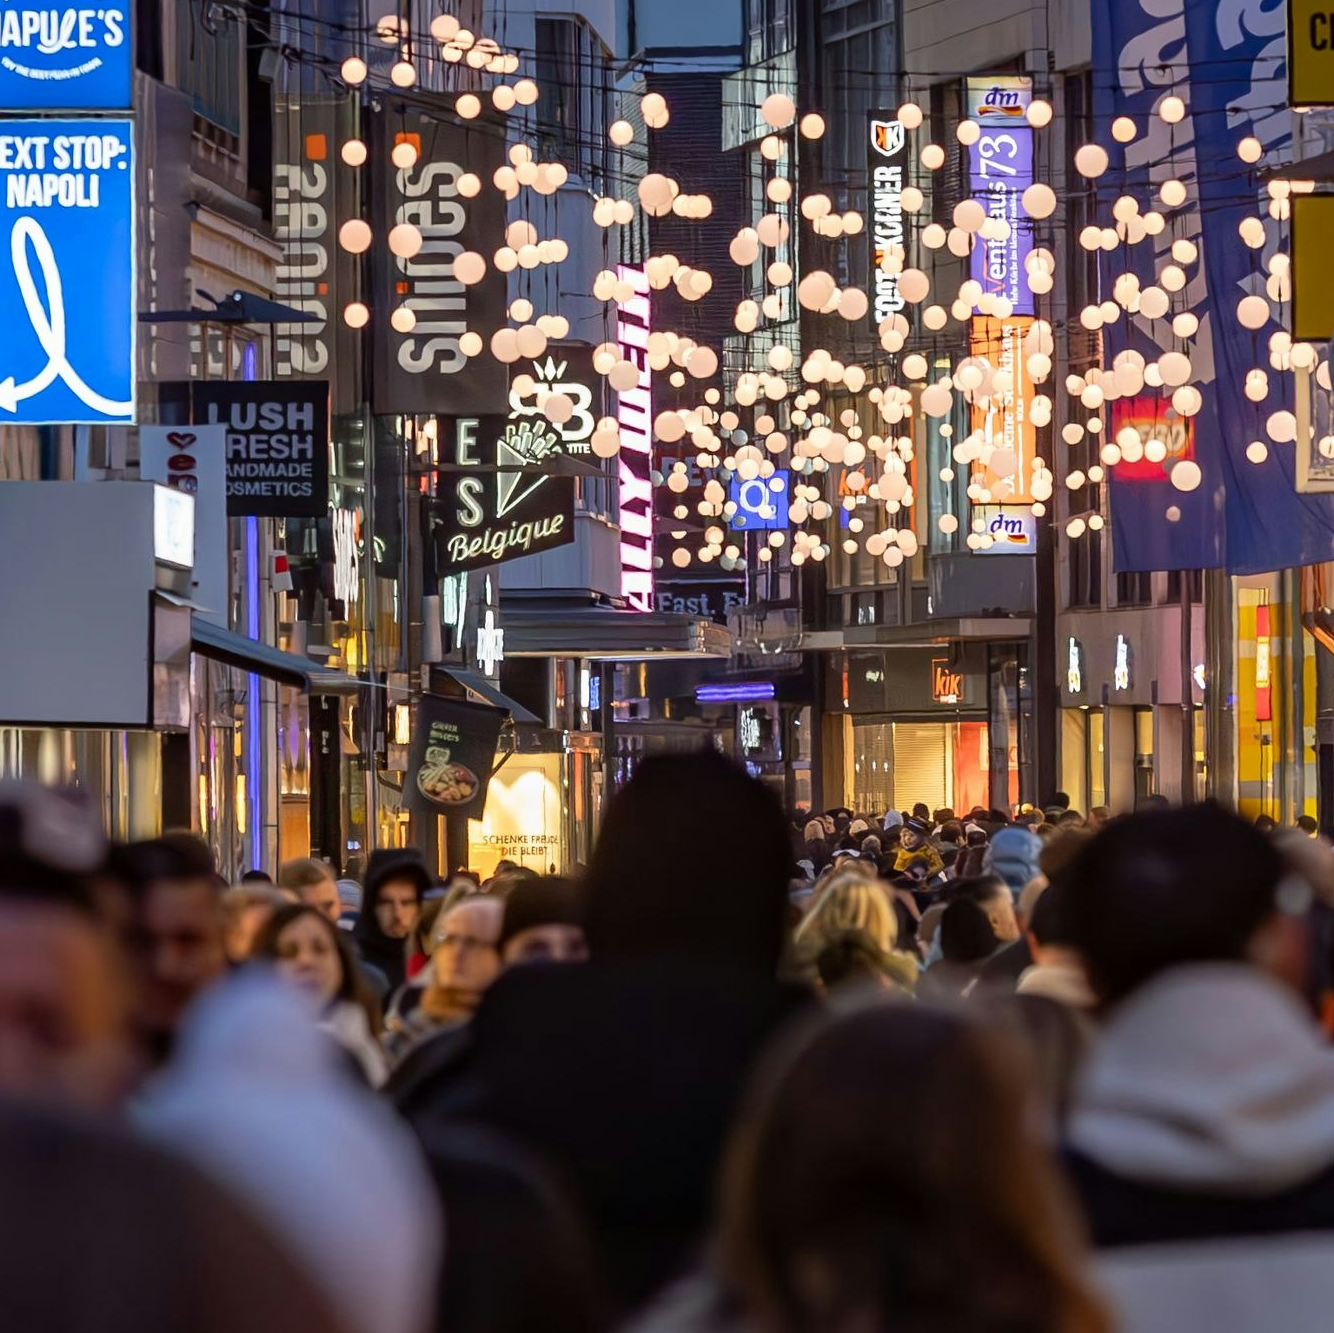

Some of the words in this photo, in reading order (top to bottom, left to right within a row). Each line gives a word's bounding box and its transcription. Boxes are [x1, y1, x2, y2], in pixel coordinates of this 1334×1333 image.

[985, 87, 1019, 107] dm
[53, 135, 127, 169] STOP:
[6, 173, 99, 208] NAPOLI
[226, 434, 314, 459] RESH
[226, 463, 313, 477] ANDMADE
[226, 481, 313, 496] SMETICS
[989, 514, 1023, 534] dm
[447, 513, 565, 562] Belgique
[618, 457, 654, 613] ALLY
[482, 834, 529, 845] SCHENKE
[501, 846, 518, 856] DIE
